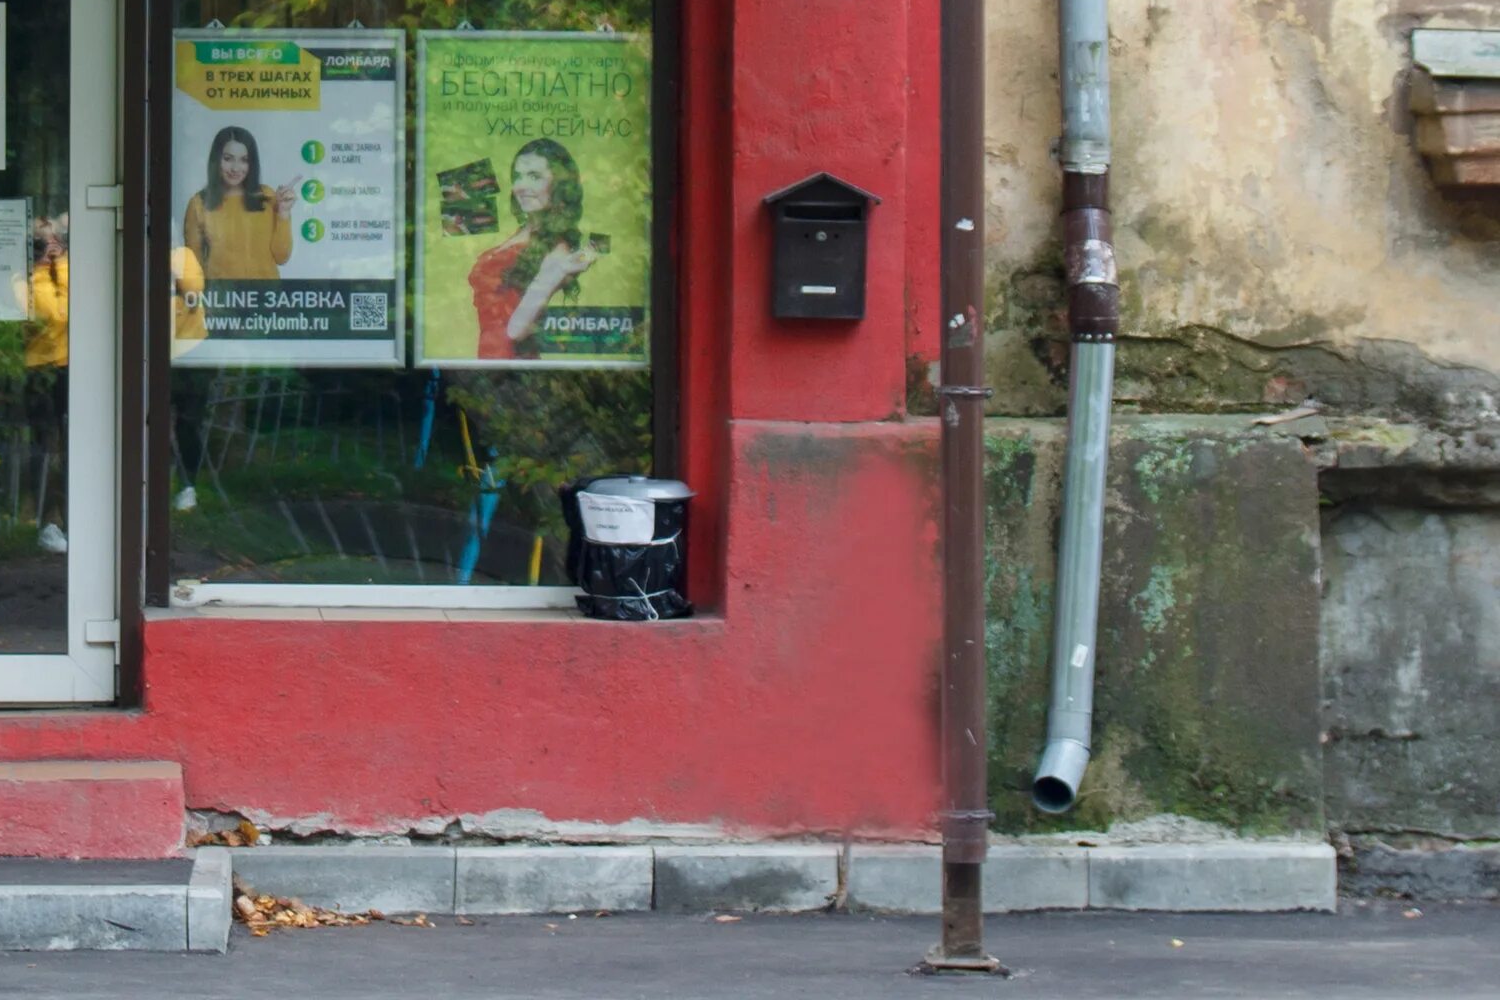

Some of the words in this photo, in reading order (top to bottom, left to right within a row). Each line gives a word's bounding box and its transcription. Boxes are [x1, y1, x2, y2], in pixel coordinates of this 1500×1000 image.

[211, 48, 233, 60] ВЫ
[325, 55, 391, 68] ЛОМБАРД
[206, 71, 214, 82] В
[219, 71, 255, 82] ТРЕХ
[260, 71, 312, 82] ШАГАХ
[442, 70, 632, 98] БЕСПЛАТНО
[206, 87, 225, 99] ОТ
[230, 87, 312, 99] НАЛИЧНЫХ
[486, 117, 534, 137] УЖЕ
[540, 114, 632, 137] СЕЙЧАС
[308, 144, 316, 161] 1
[308, 183, 317, 199] 2
[308, 222, 317, 239] 3
[185, 290, 259, 309] ONLINE
[264, 290, 346, 309] ЗАЯВКА
[203, 312, 329, 334] www.citylomb.ru
[544, 316, 634, 333] ЛОМБАРД
